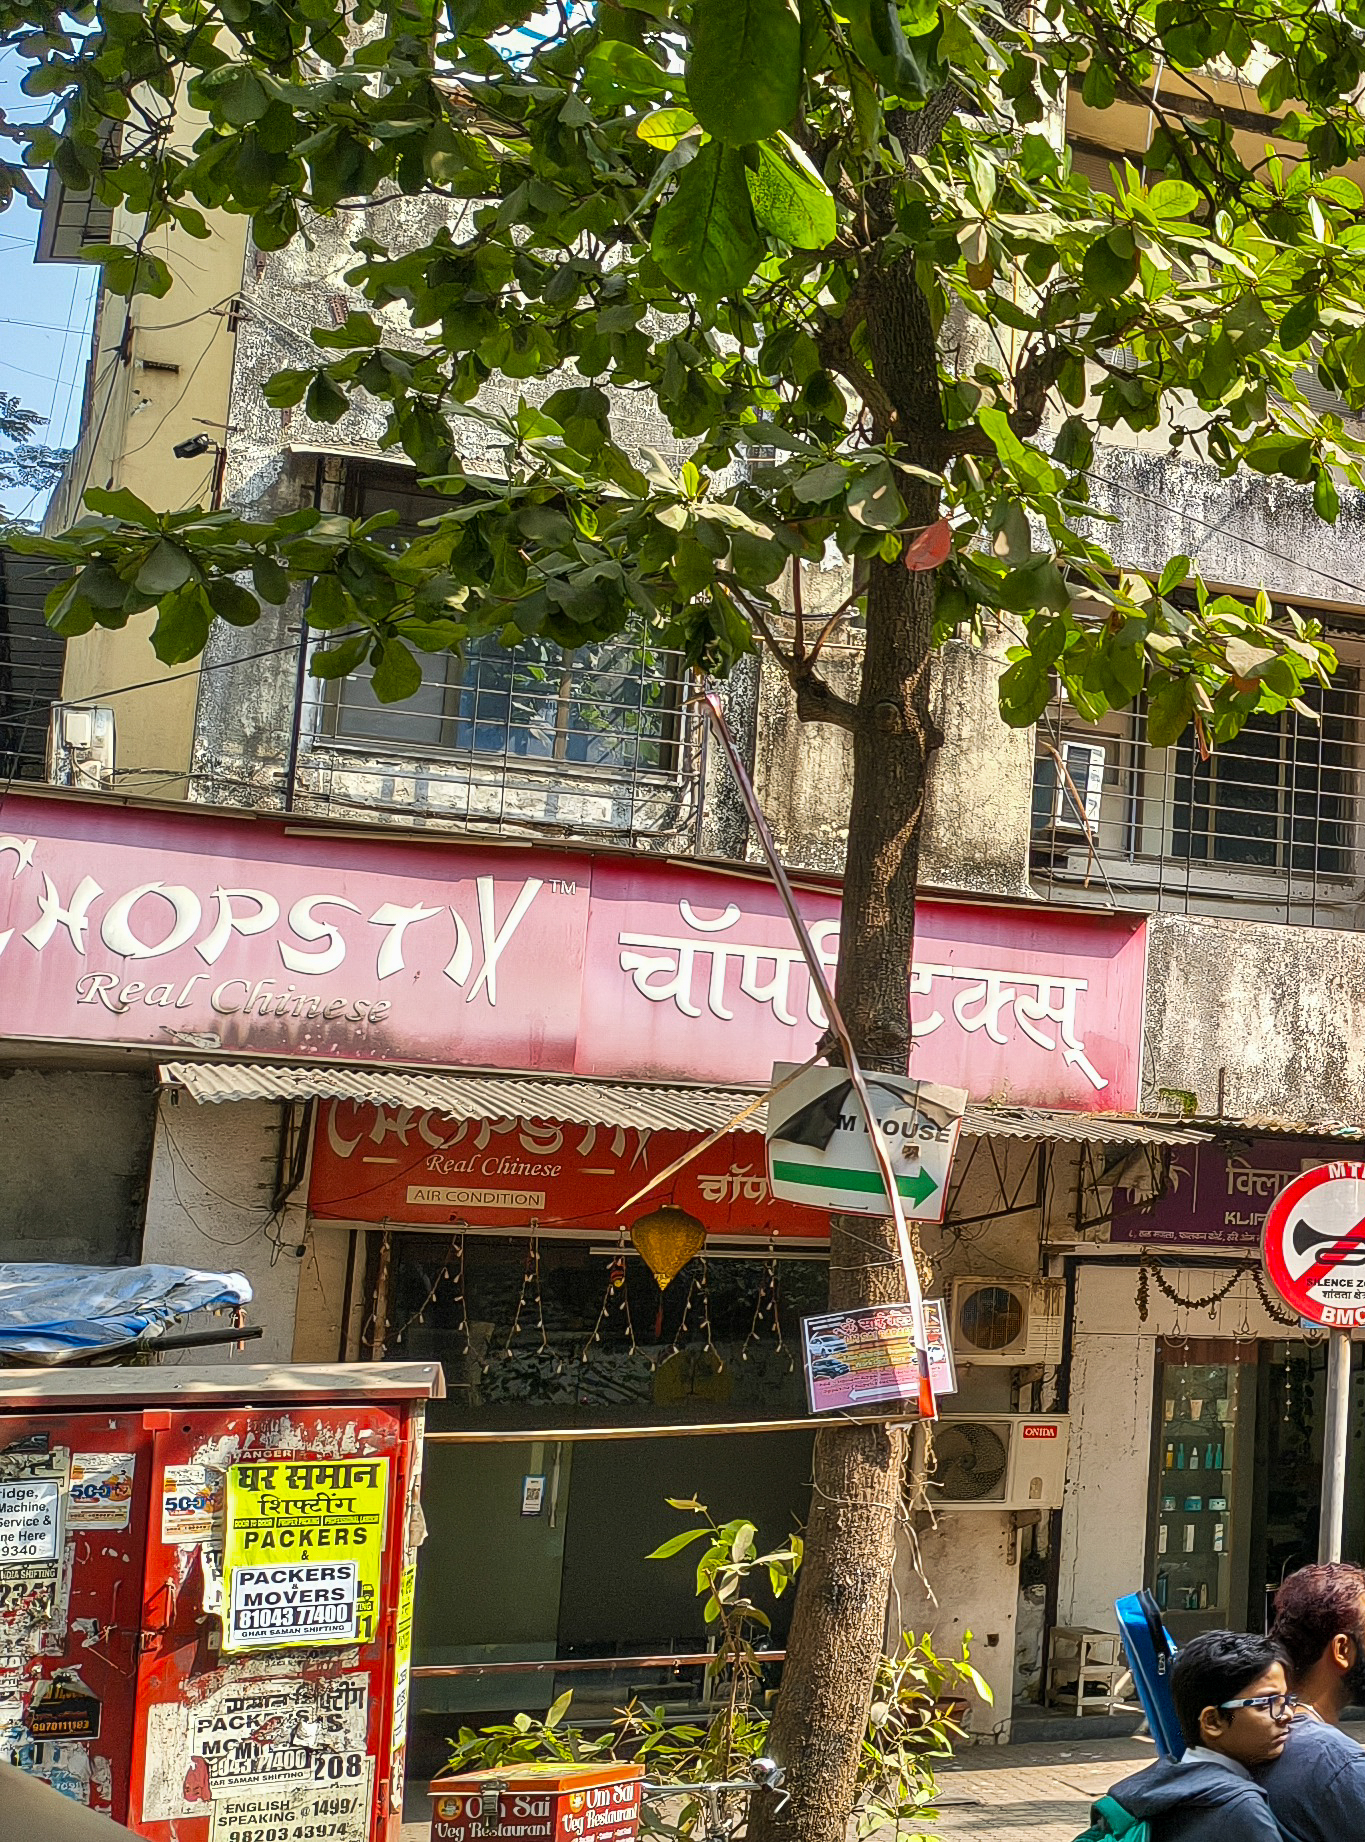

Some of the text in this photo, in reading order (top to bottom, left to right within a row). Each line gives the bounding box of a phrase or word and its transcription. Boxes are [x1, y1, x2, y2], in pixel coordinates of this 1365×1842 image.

[76, 971, 392, 1022] Real Chinese
[426, 1153, 562, 1179] Real Chinese
[413, 1189, 541, 1207] AIR CONDITION
[1306, 1278, 1353, 1288] SILENCE
[1025, 1428, 1056, 1438] ONIDA
[238, 1463, 381, 1491] घर समान
[258, 1492, 357, 1515] शिफ्टींग
[43, 1516, 51, 1526] &
[19, 1531, 46, 1541] Here
[244, 1527, 368, 1550] PACKERS
[301, 1550, 309, 1561] &
[21, 1568, 56, 1579] SHIFTING
[239, 1566, 352, 1586] PACKERS
[244, 1588, 345, 1607] MOVERS
[239, 1604, 348, 1629] 81043 77400
[242, 1624, 345, 1638] GHAR SAMAN SHIFTING
[227, 1772, 304, 1785] SAMAN SHIFTING
[585, 1783, 634, 1809] Om Sai
[225, 1801, 289, 1814] ENGLISH
[300, 1806, 310, 1817] @
[513, 1795, 550, 1818] Sai
[218, 1811, 295, 1827] SPEAKING
[562, 1813, 585, 1835] Veg
[585, 1803, 638, 1829] Restaurant
[229, 1823, 348, 1842] 98203 43974
[435, 1823, 465, 1842] Veg
